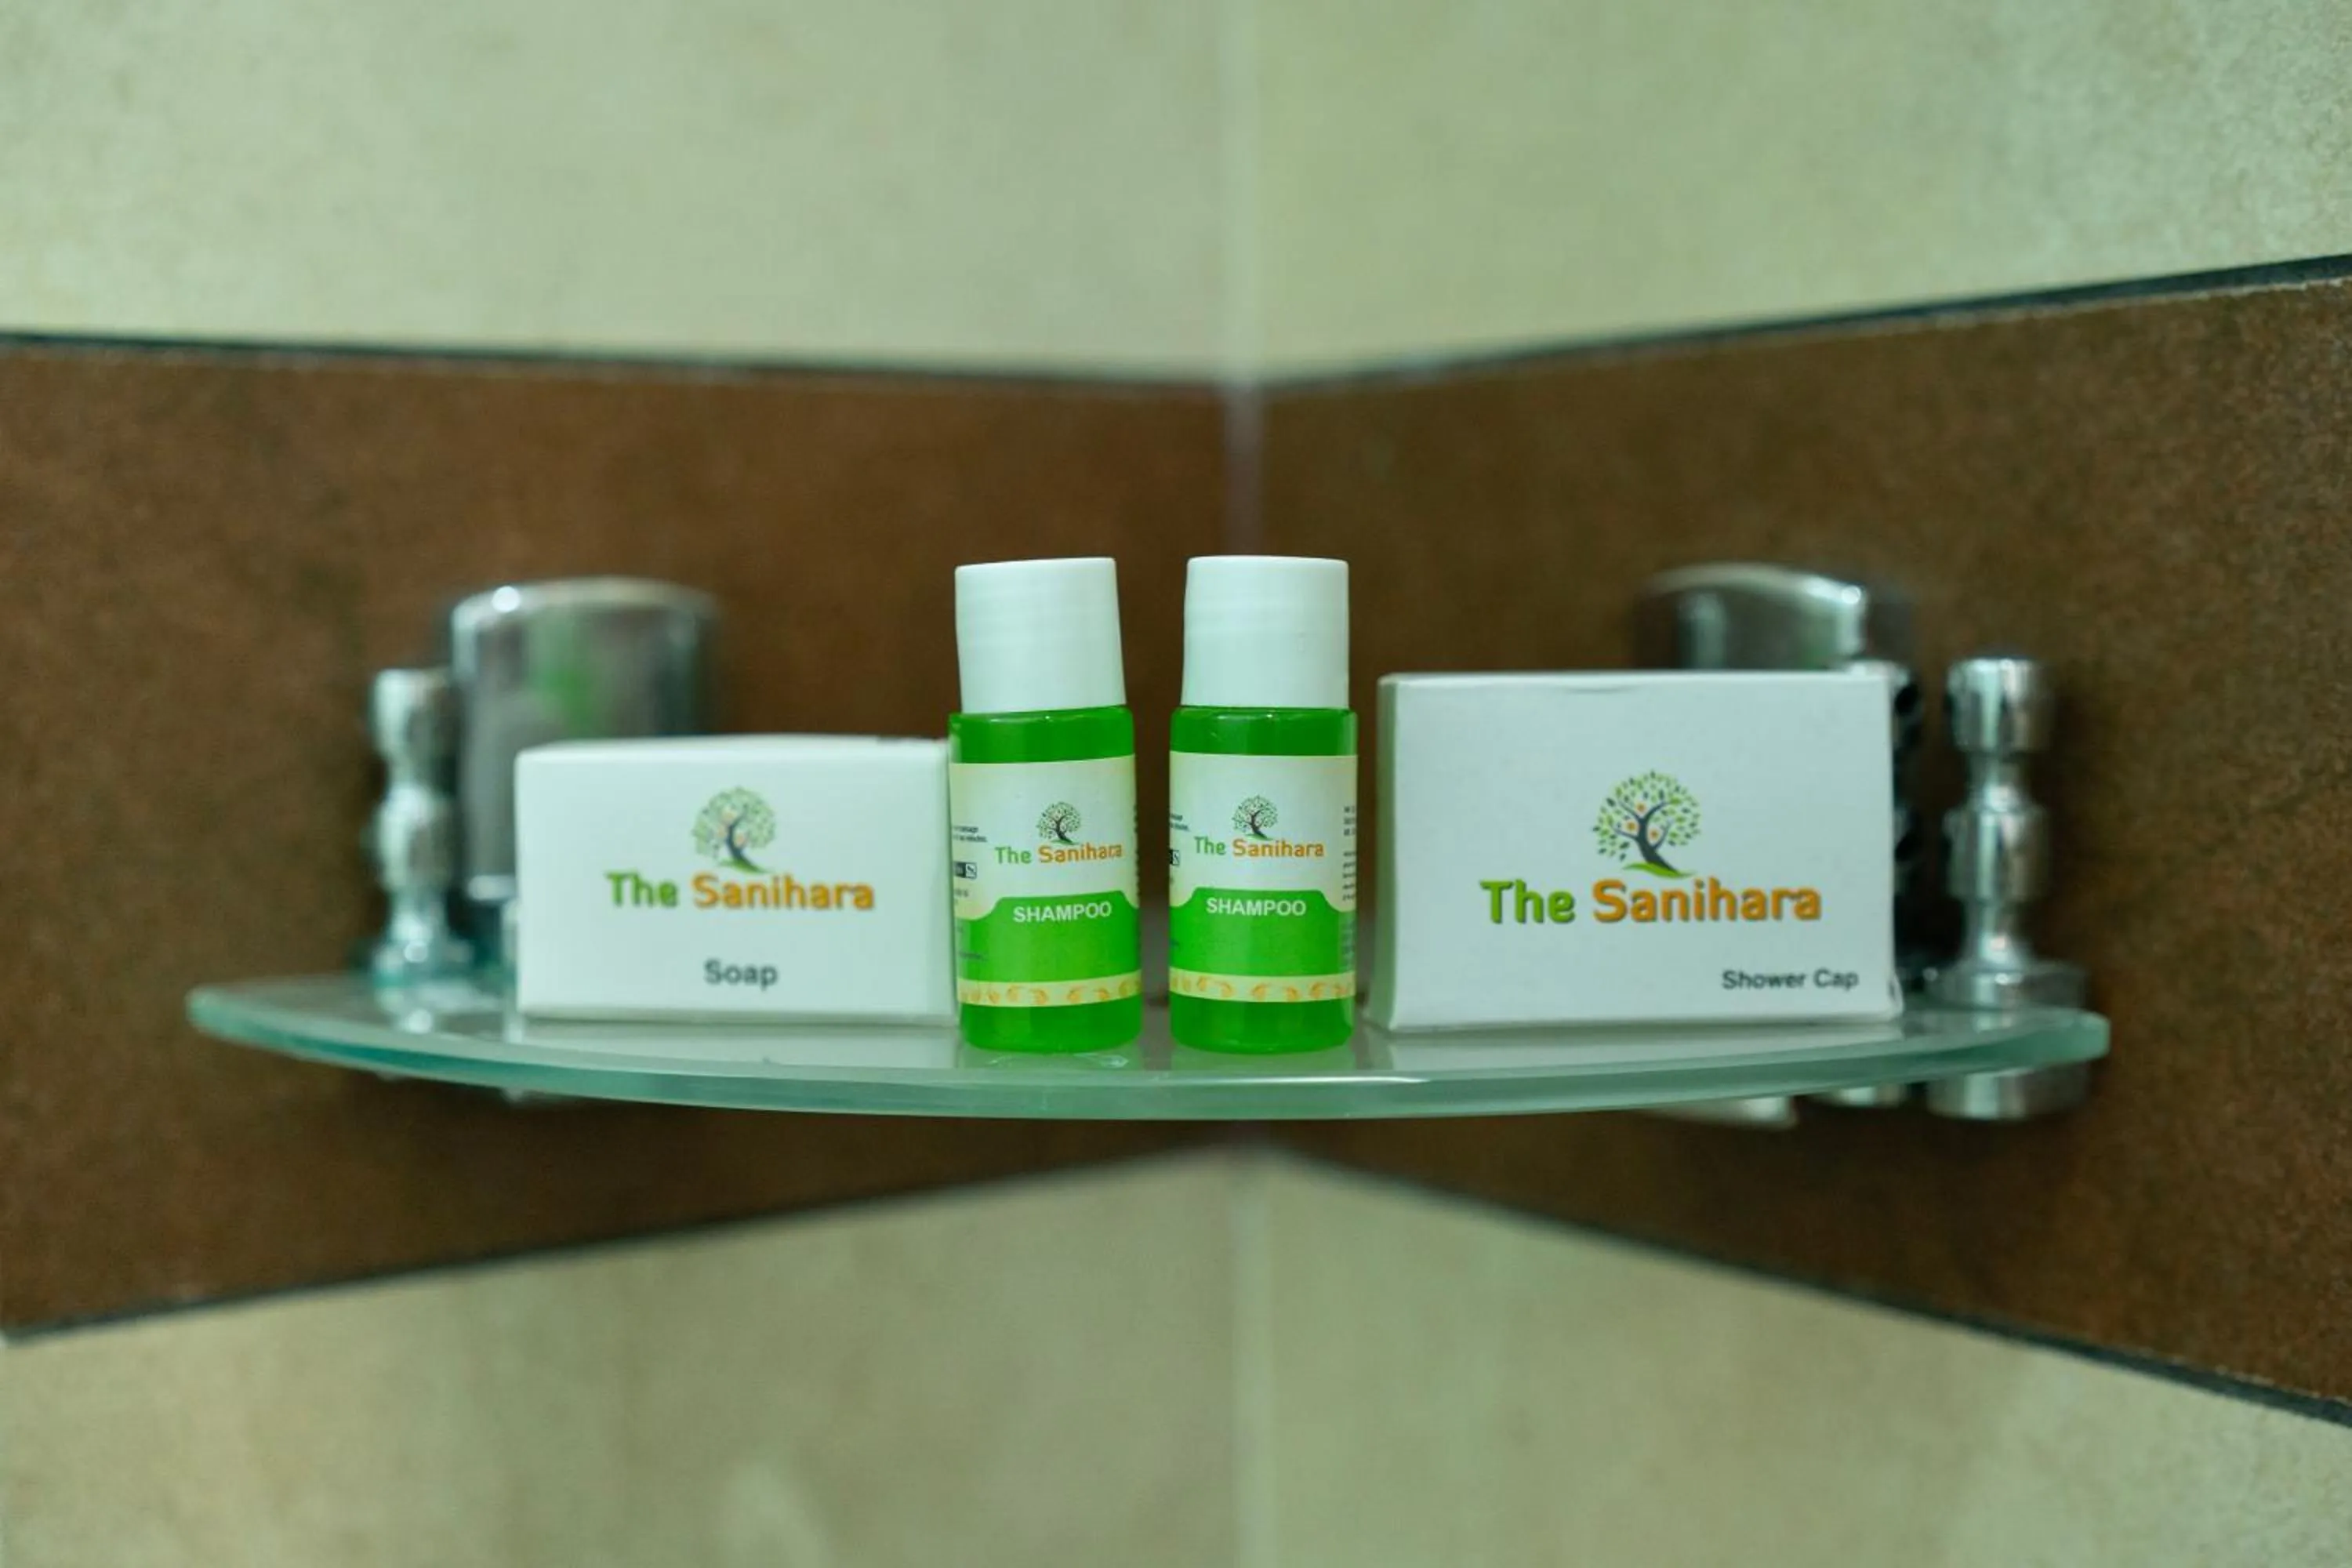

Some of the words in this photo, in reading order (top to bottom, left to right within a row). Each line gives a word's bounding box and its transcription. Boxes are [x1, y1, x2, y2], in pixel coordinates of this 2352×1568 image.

[994, 846, 1032, 864] The
[1038, 843, 1123, 863] Sanihara
[1194, 837, 1226, 855] The
[1232, 839, 1325, 857] Sanihara
[604, 871, 679, 908] The
[691, 872, 875, 911] Sanihara
[1479, 879, 1576, 924] The
[1592, 876, 1823, 923] Sanihara
[1013, 902, 1112, 923] SHAMPOO
[1207, 897, 1307, 916] SHAMPOO
[704, 958, 779, 991] Soap
[1722, 970, 1806, 989] Shower
[1813, 968, 1860, 990] Cap
